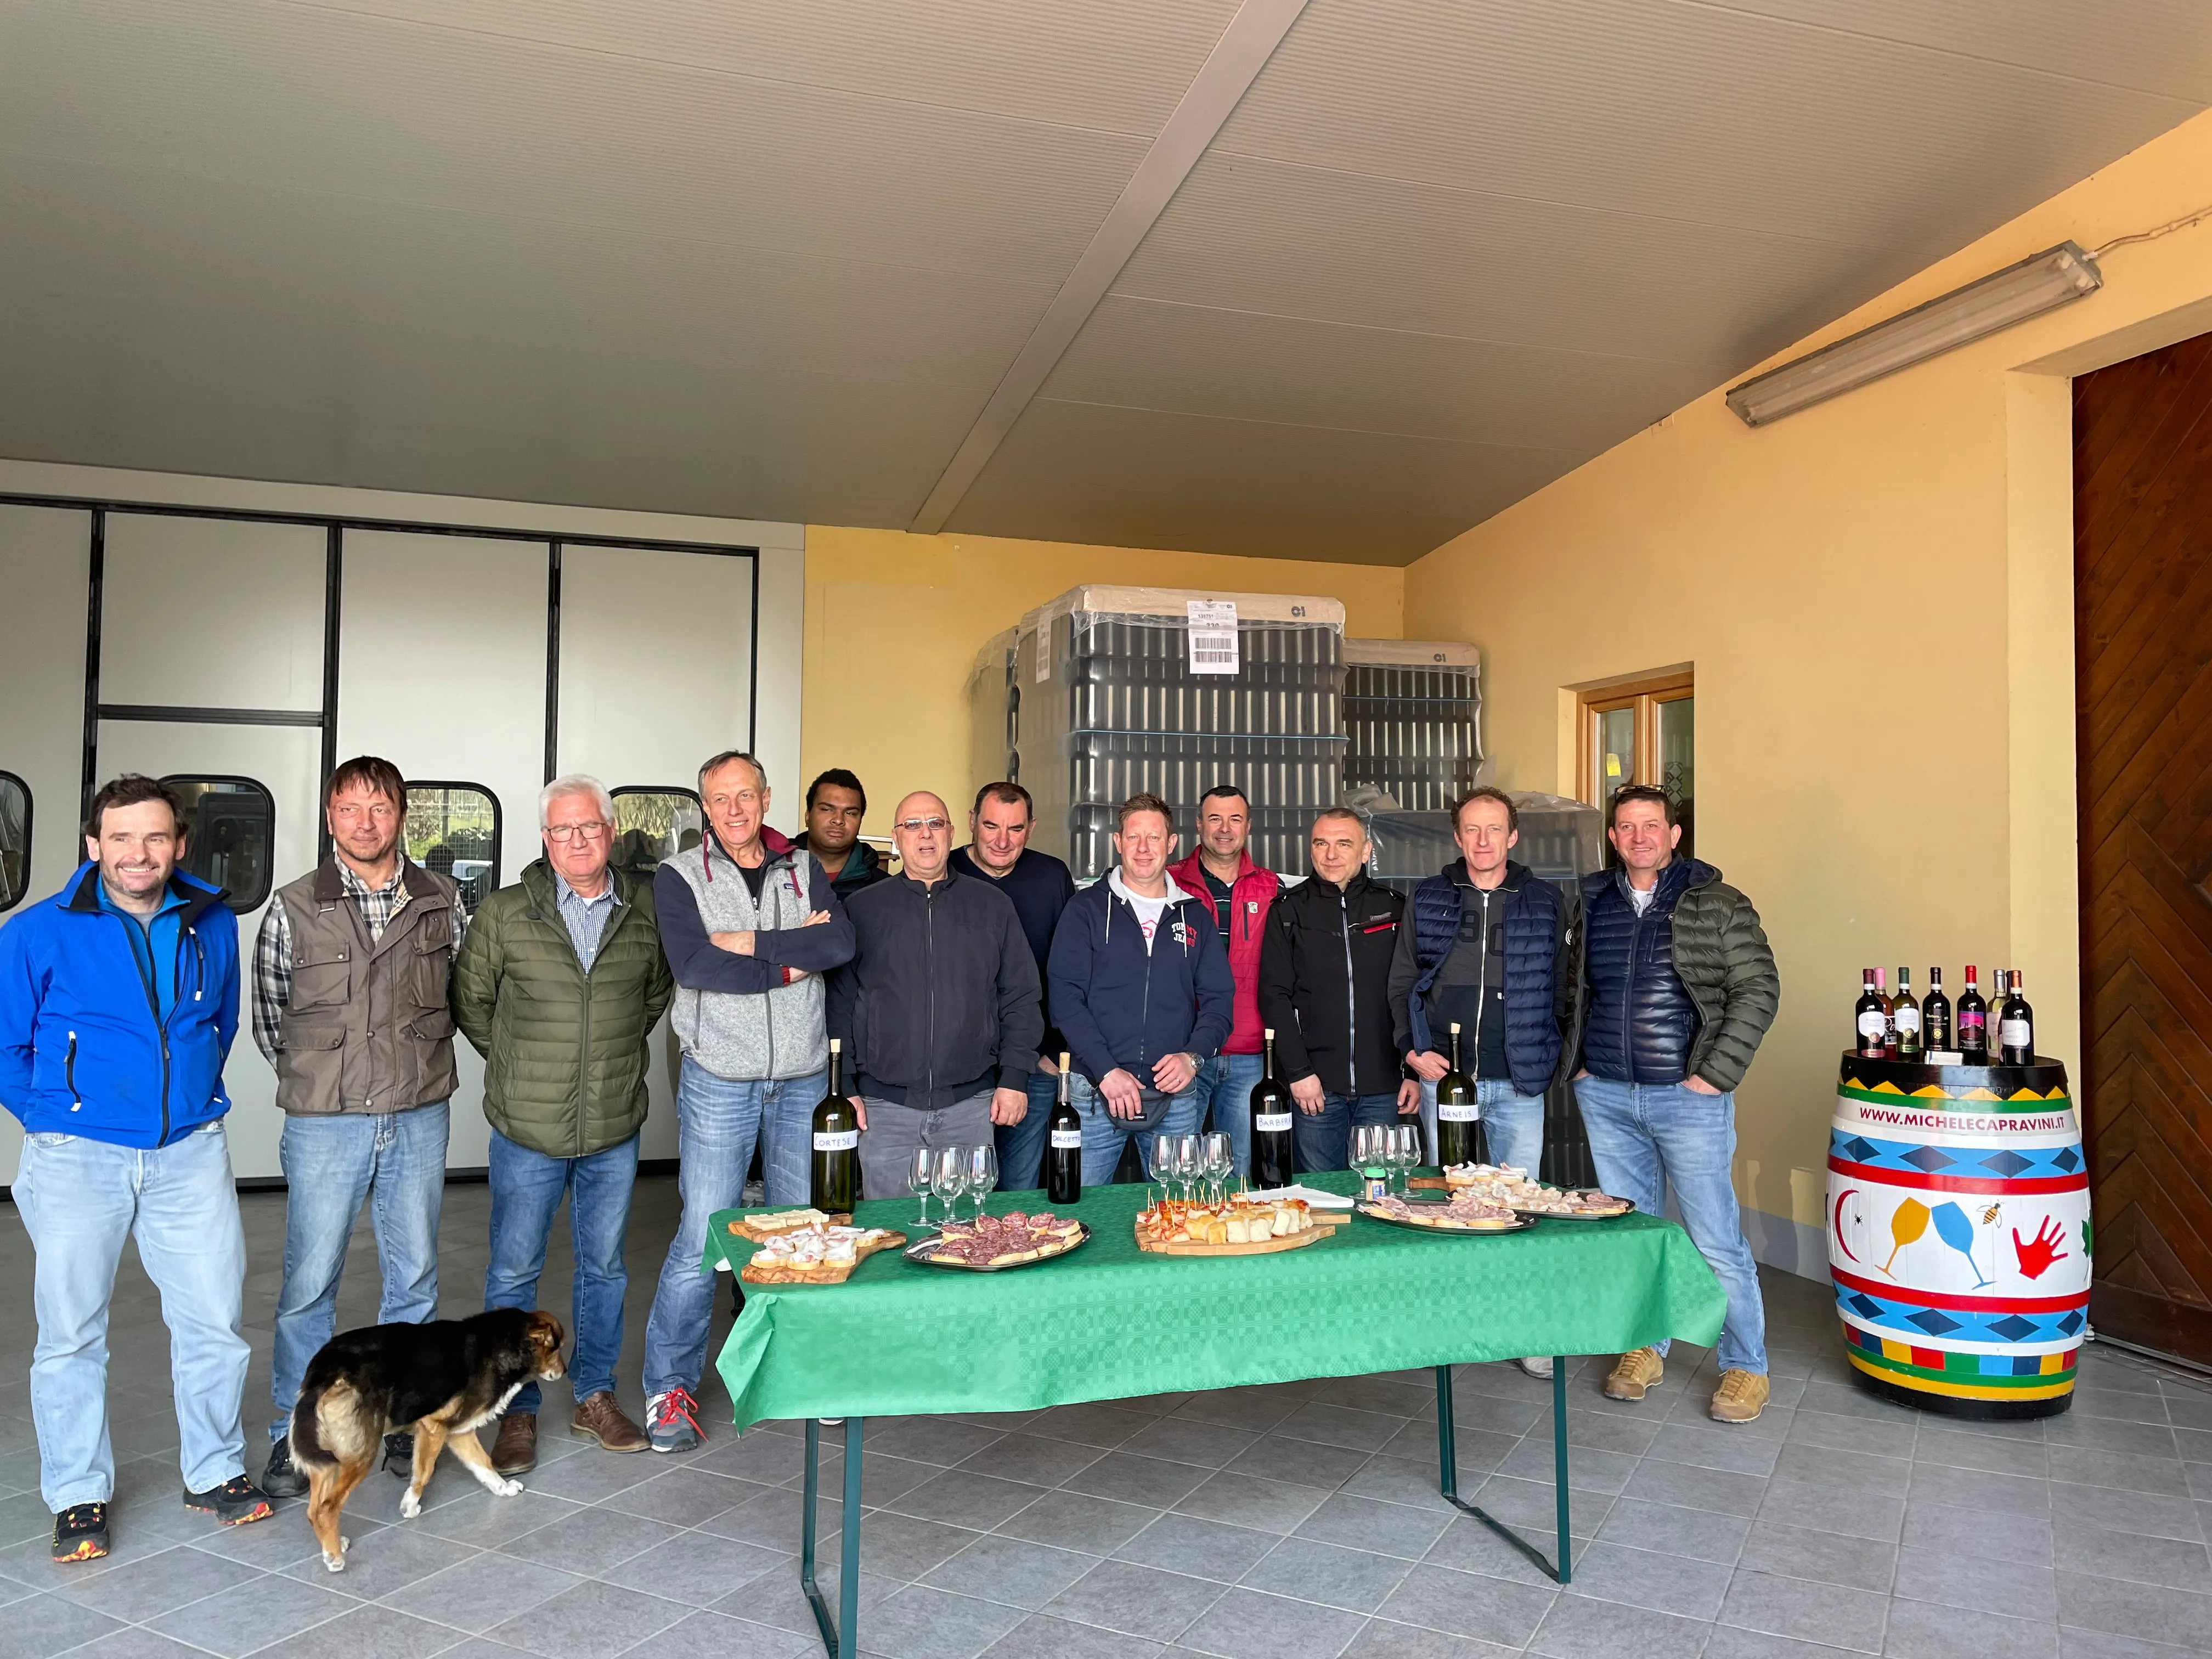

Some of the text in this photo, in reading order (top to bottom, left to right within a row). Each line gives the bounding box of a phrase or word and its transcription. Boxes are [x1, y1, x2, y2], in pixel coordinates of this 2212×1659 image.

[1441, 1108, 1471, 1118] ARNEIS
[1258, 1117, 1291, 1126] BARBERA
[1859, 1107, 2064, 1131] WWW.MICHELECAPRAVINI.IT
[815, 1135, 850, 1147] CORTESE
